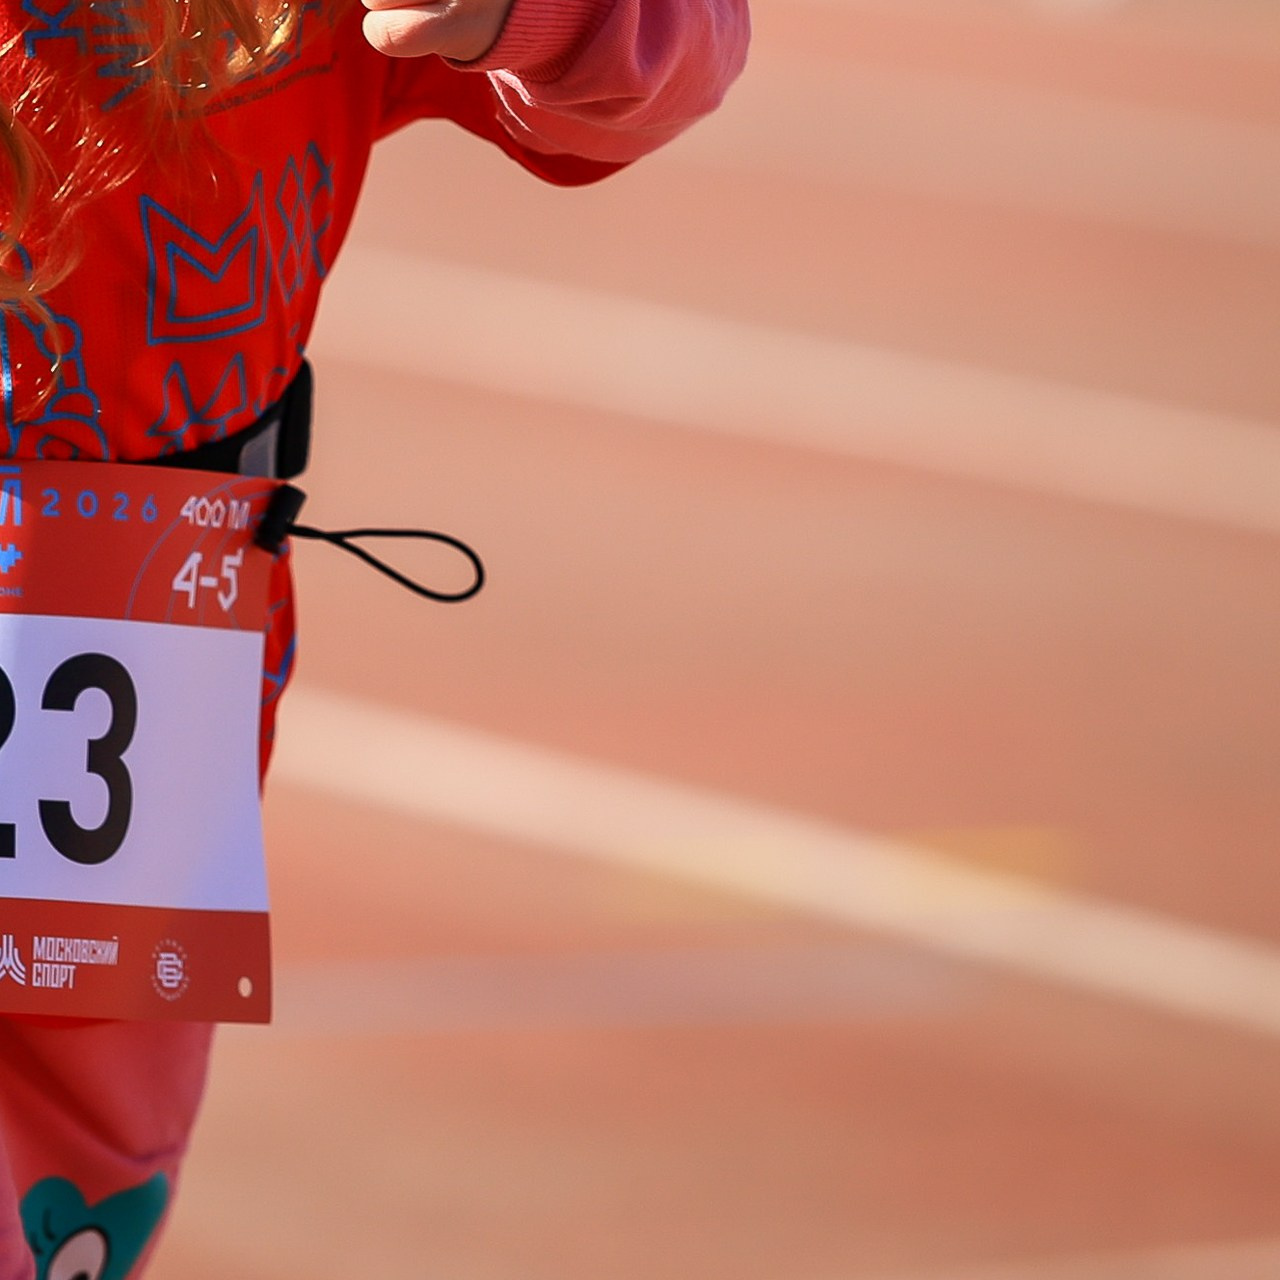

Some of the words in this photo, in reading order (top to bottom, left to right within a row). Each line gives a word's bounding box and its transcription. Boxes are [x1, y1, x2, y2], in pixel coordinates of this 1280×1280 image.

[41, 487, 158, 523] 2026
[172, 547, 244, 612] 4-5
[32, 935, 119, 966] МОСКОВСКИЙ
[32, 962, 77, 989] СПОРТ
